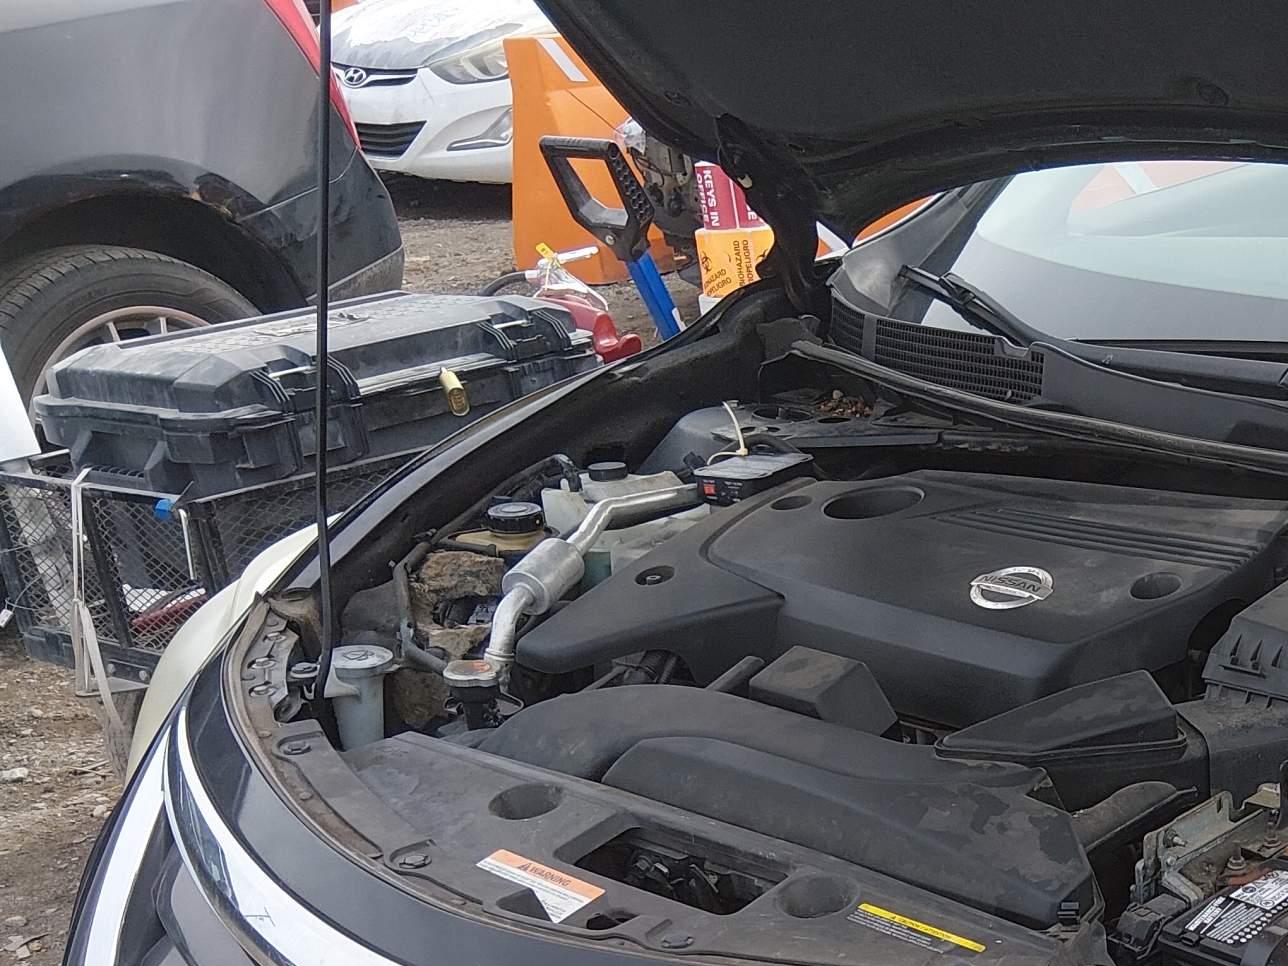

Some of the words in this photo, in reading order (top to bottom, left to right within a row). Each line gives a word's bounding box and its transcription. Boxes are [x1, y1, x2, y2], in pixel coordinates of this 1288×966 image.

[703, 169, 717, 208] KEYS
[710, 211, 720, 227] IN
[981, 575, 1040, 593] NISSAN
[528, 865, 572, 887] WARNING
